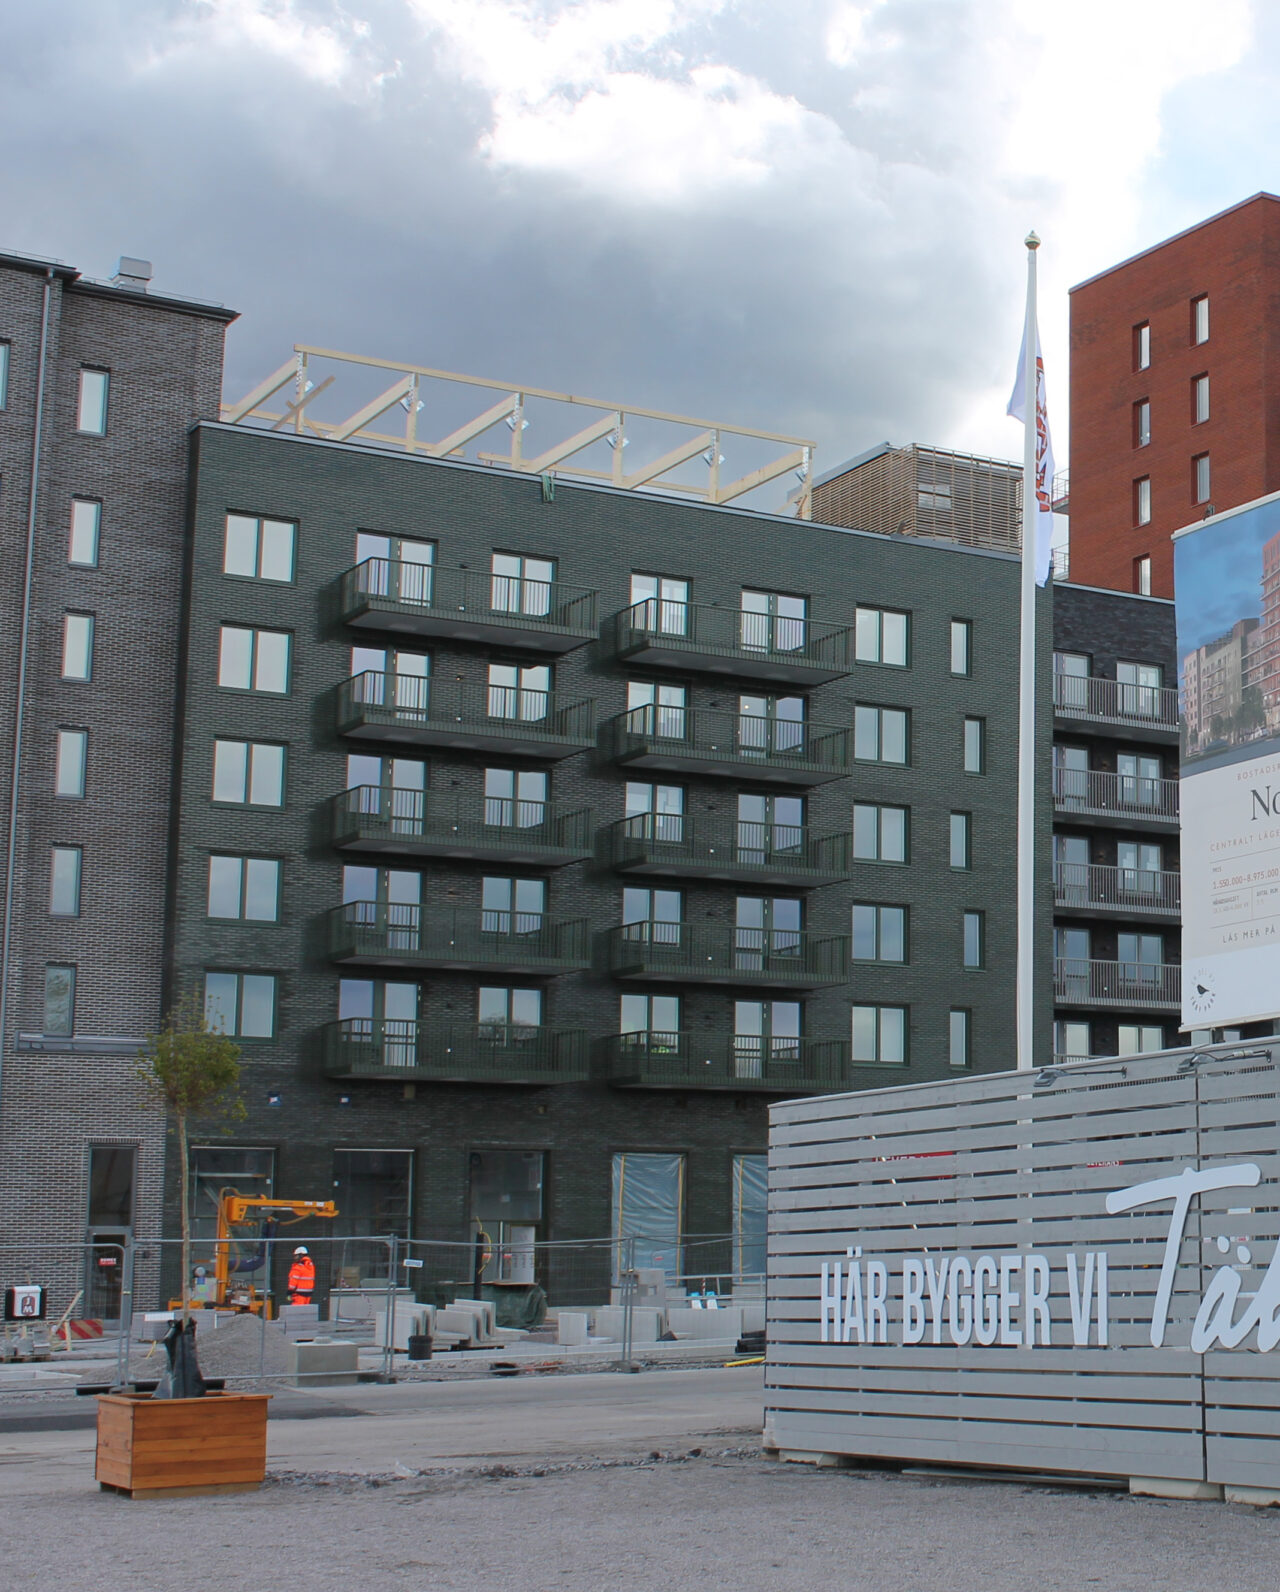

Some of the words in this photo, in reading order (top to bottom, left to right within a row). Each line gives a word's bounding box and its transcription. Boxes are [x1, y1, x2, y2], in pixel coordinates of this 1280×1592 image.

[1243, 928, 1260, 940] MER
[820, 1246, 888, 1343] HÄR
[902, 1254, 1052, 1346] BYGGER
[1066, 1251, 1108, 1346] VI
